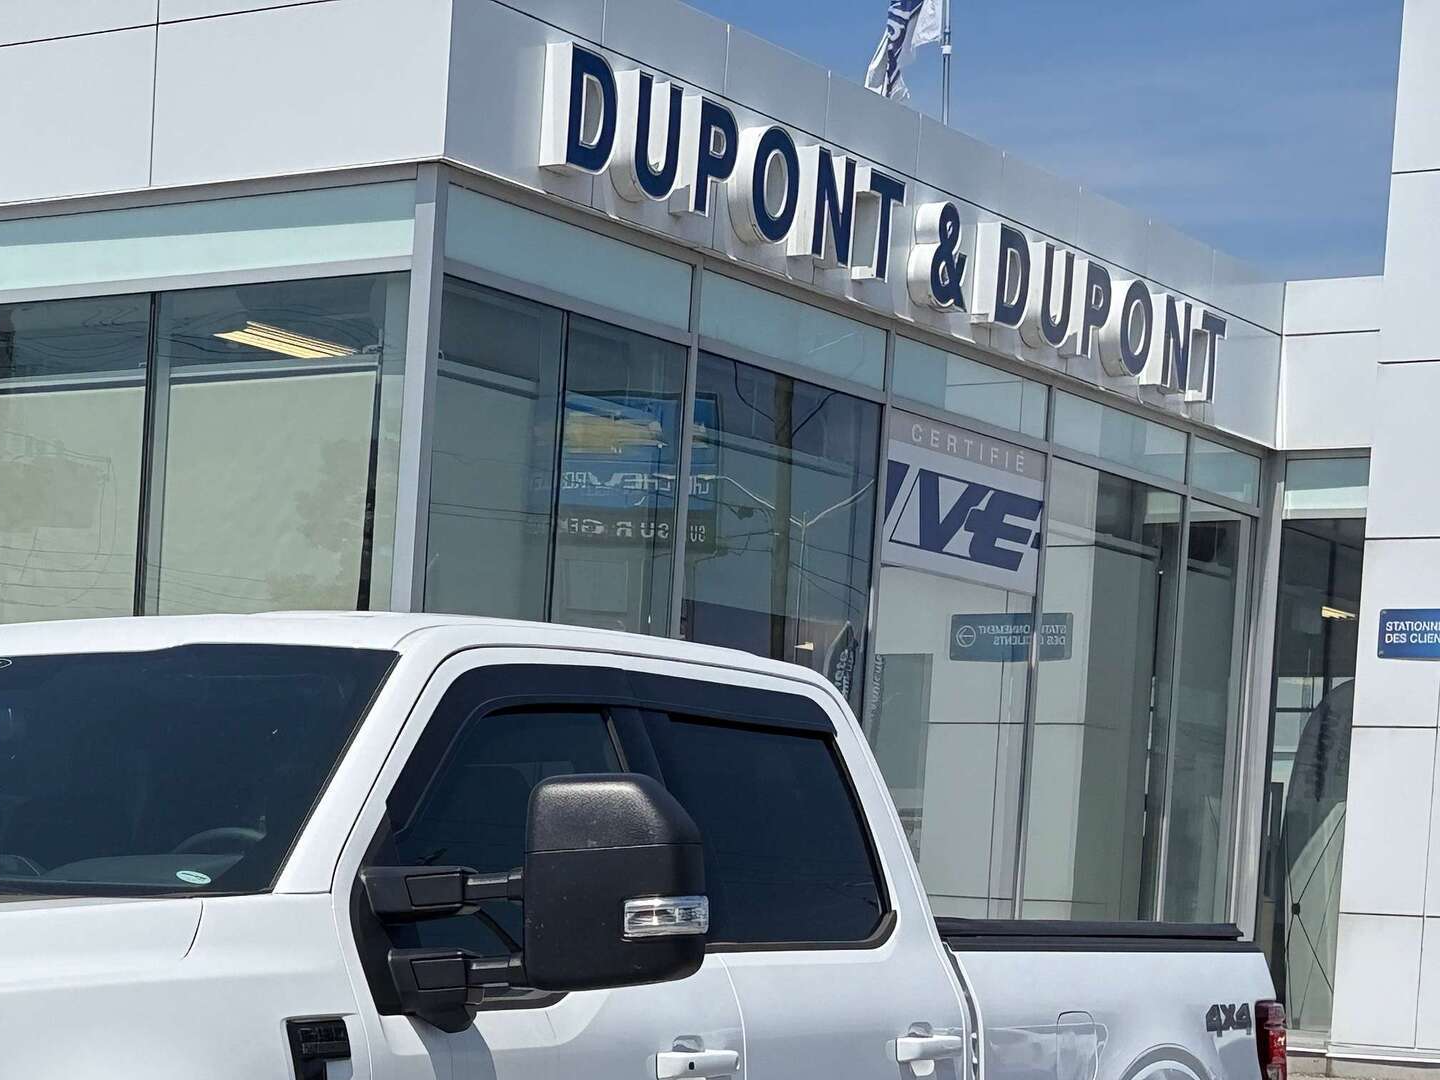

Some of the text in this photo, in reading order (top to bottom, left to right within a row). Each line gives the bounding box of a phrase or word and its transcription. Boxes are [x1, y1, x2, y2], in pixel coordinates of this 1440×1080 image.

[555, 41, 907, 284] DUPONT
[920, 201, 967, 313] &
[980, 221, 1228, 403] DUPONT
[911, 423, 1026, 473] CERTIFIÉ
[1385, 620, 1440, 632] STATIONN
[1385, 633, 1407, 644] DES
